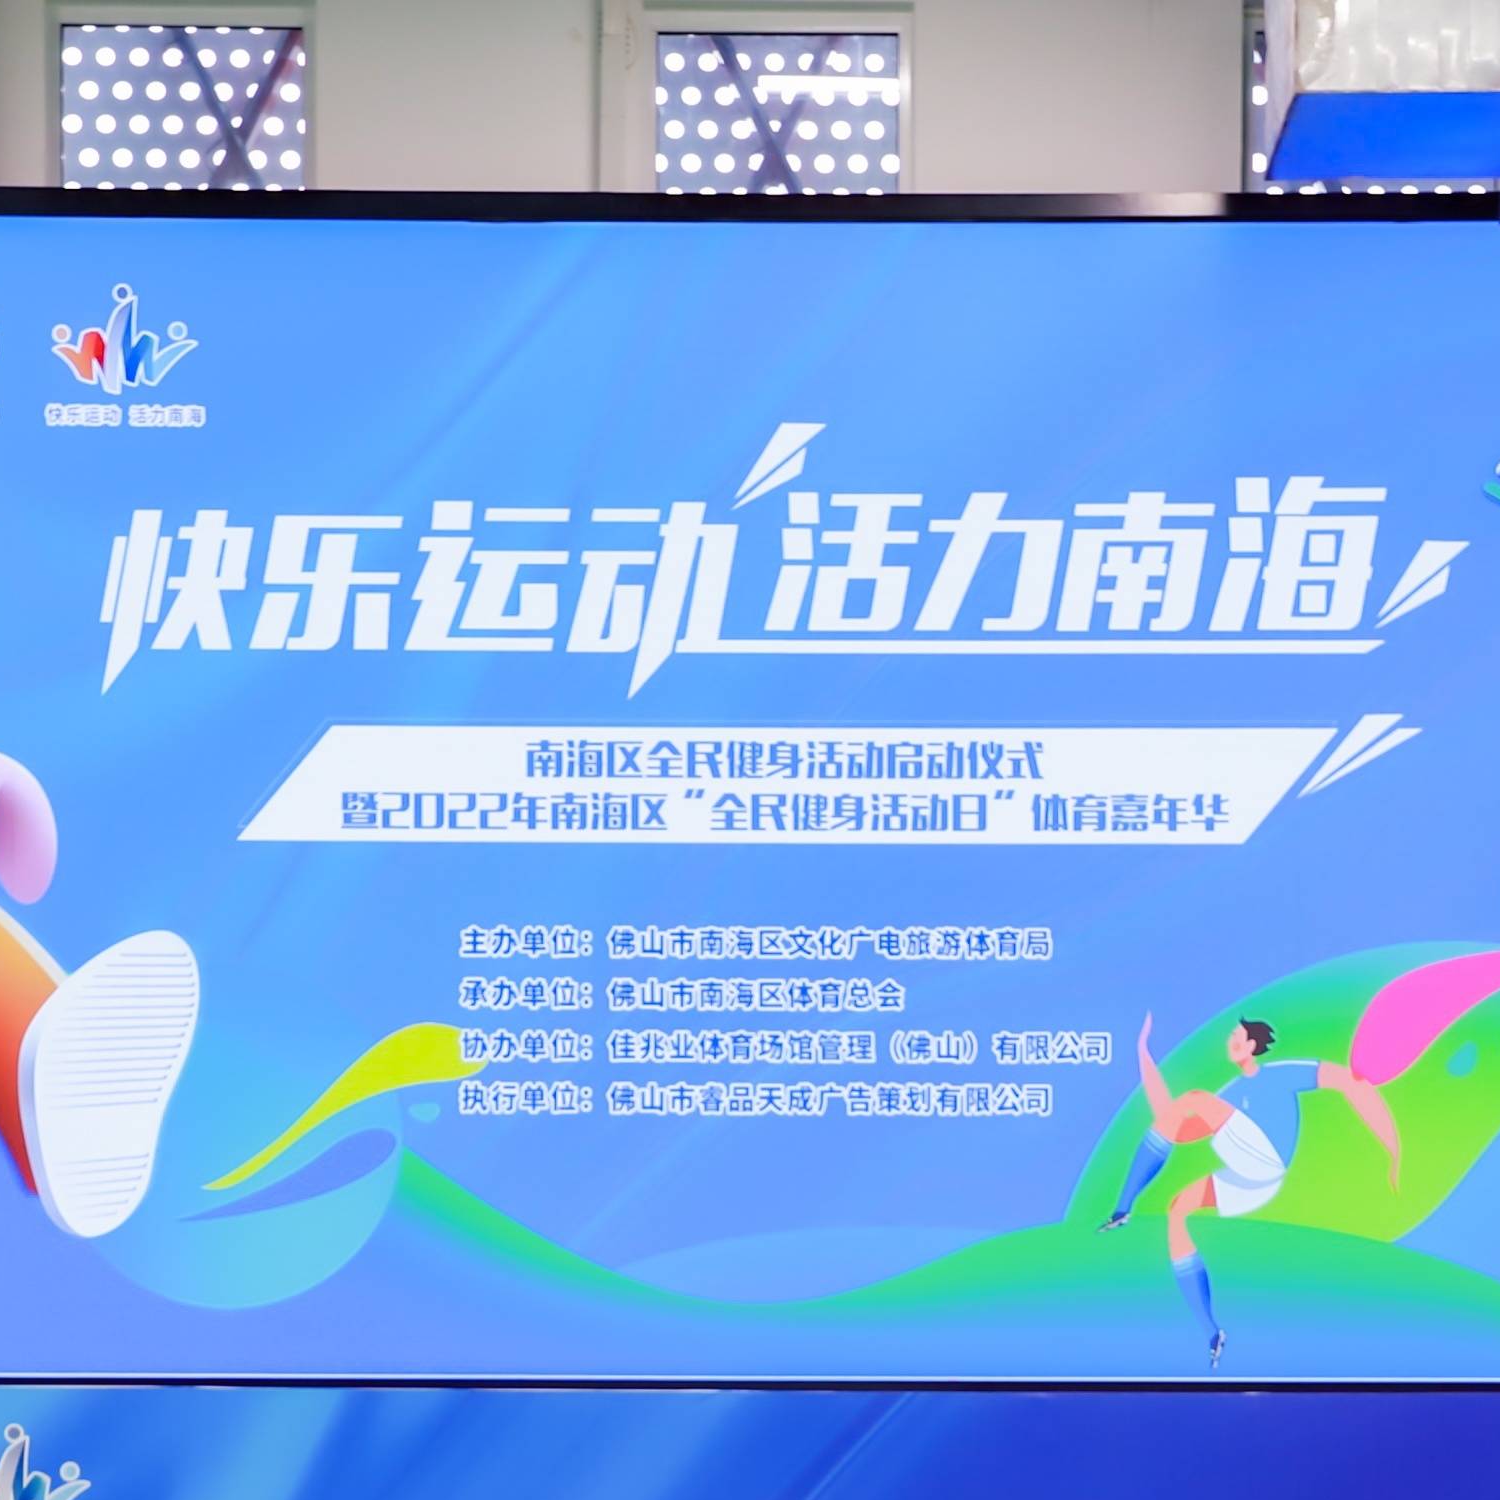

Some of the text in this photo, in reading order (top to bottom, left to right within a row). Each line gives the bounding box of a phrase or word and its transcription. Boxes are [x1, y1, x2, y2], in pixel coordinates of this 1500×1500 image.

[46, 404, 205, 427] 快乐运动 活力南海
[100, 476, 1387, 698] 快乐运动 活力南海
[526, 740, 1044, 780] 南海区全民健身活动启动仪式
